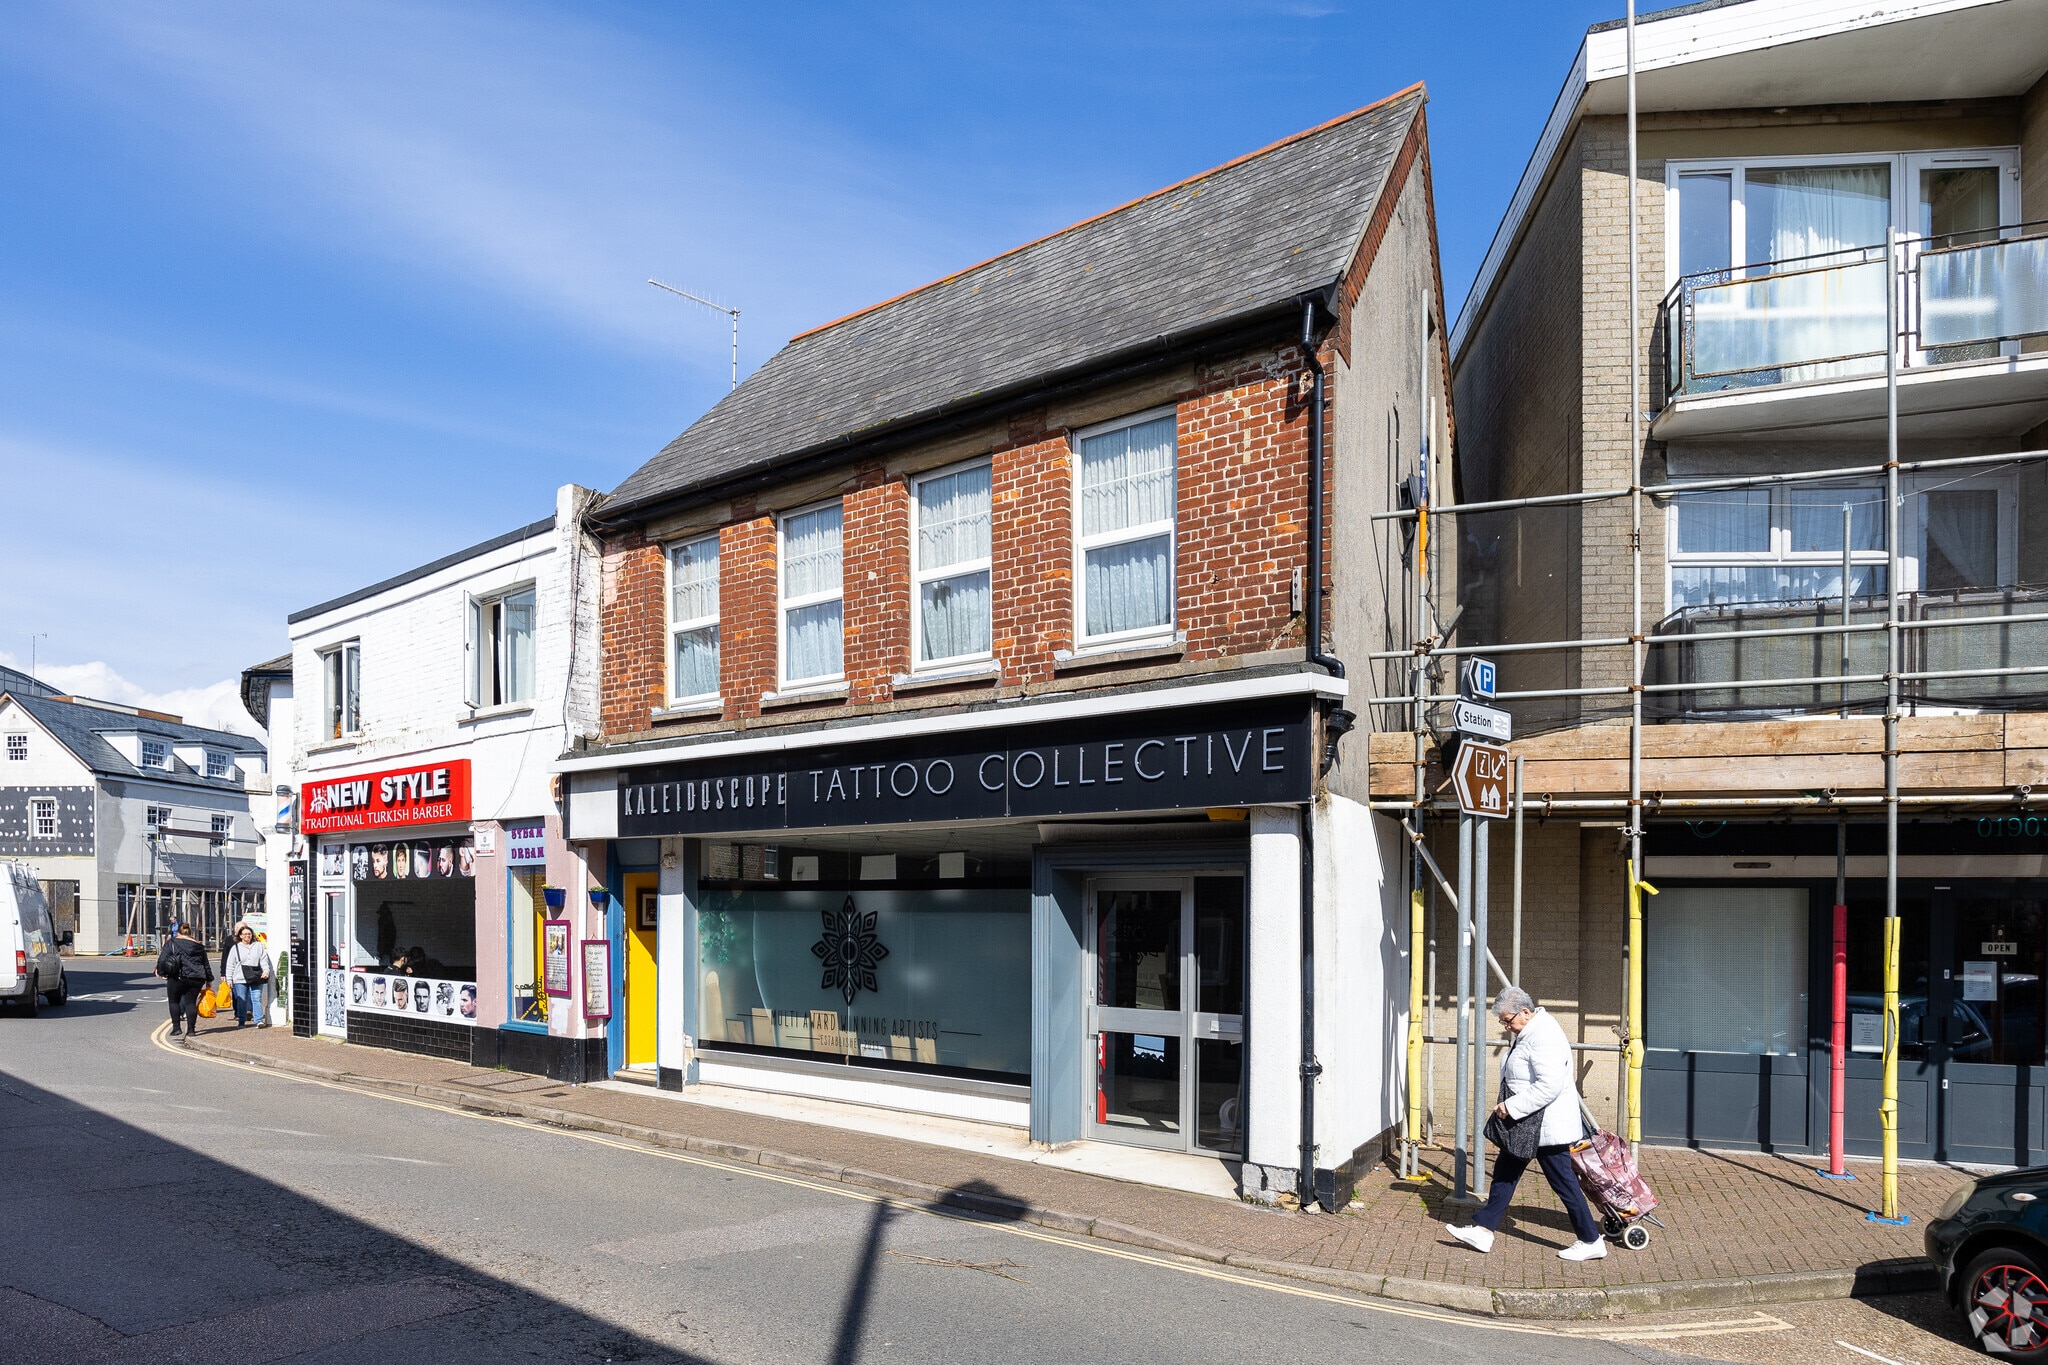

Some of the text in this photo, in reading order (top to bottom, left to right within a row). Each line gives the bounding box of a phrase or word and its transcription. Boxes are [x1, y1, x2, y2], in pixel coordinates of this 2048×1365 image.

[1483, 669, 1492, 689] P
[1463, 710, 1493, 729] Station
[624, 728, 1285, 816] KALEIDOSCOPE TATTOO COLLECTIVE
[326, 768, 448, 809] NEW STYLE
[305, 803, 453, 830] TRADITIONAL TURKISH BARBER
[511, 826, 544, 840] STEAM
[511, 846, 545, 860] DREAM
[288, 874, 305, 884] STYLE
[1987, 944, 2011, 952] OPEN
[770, 1010, 938, 1041] MULTI AWARD WNNING ARTISTS
